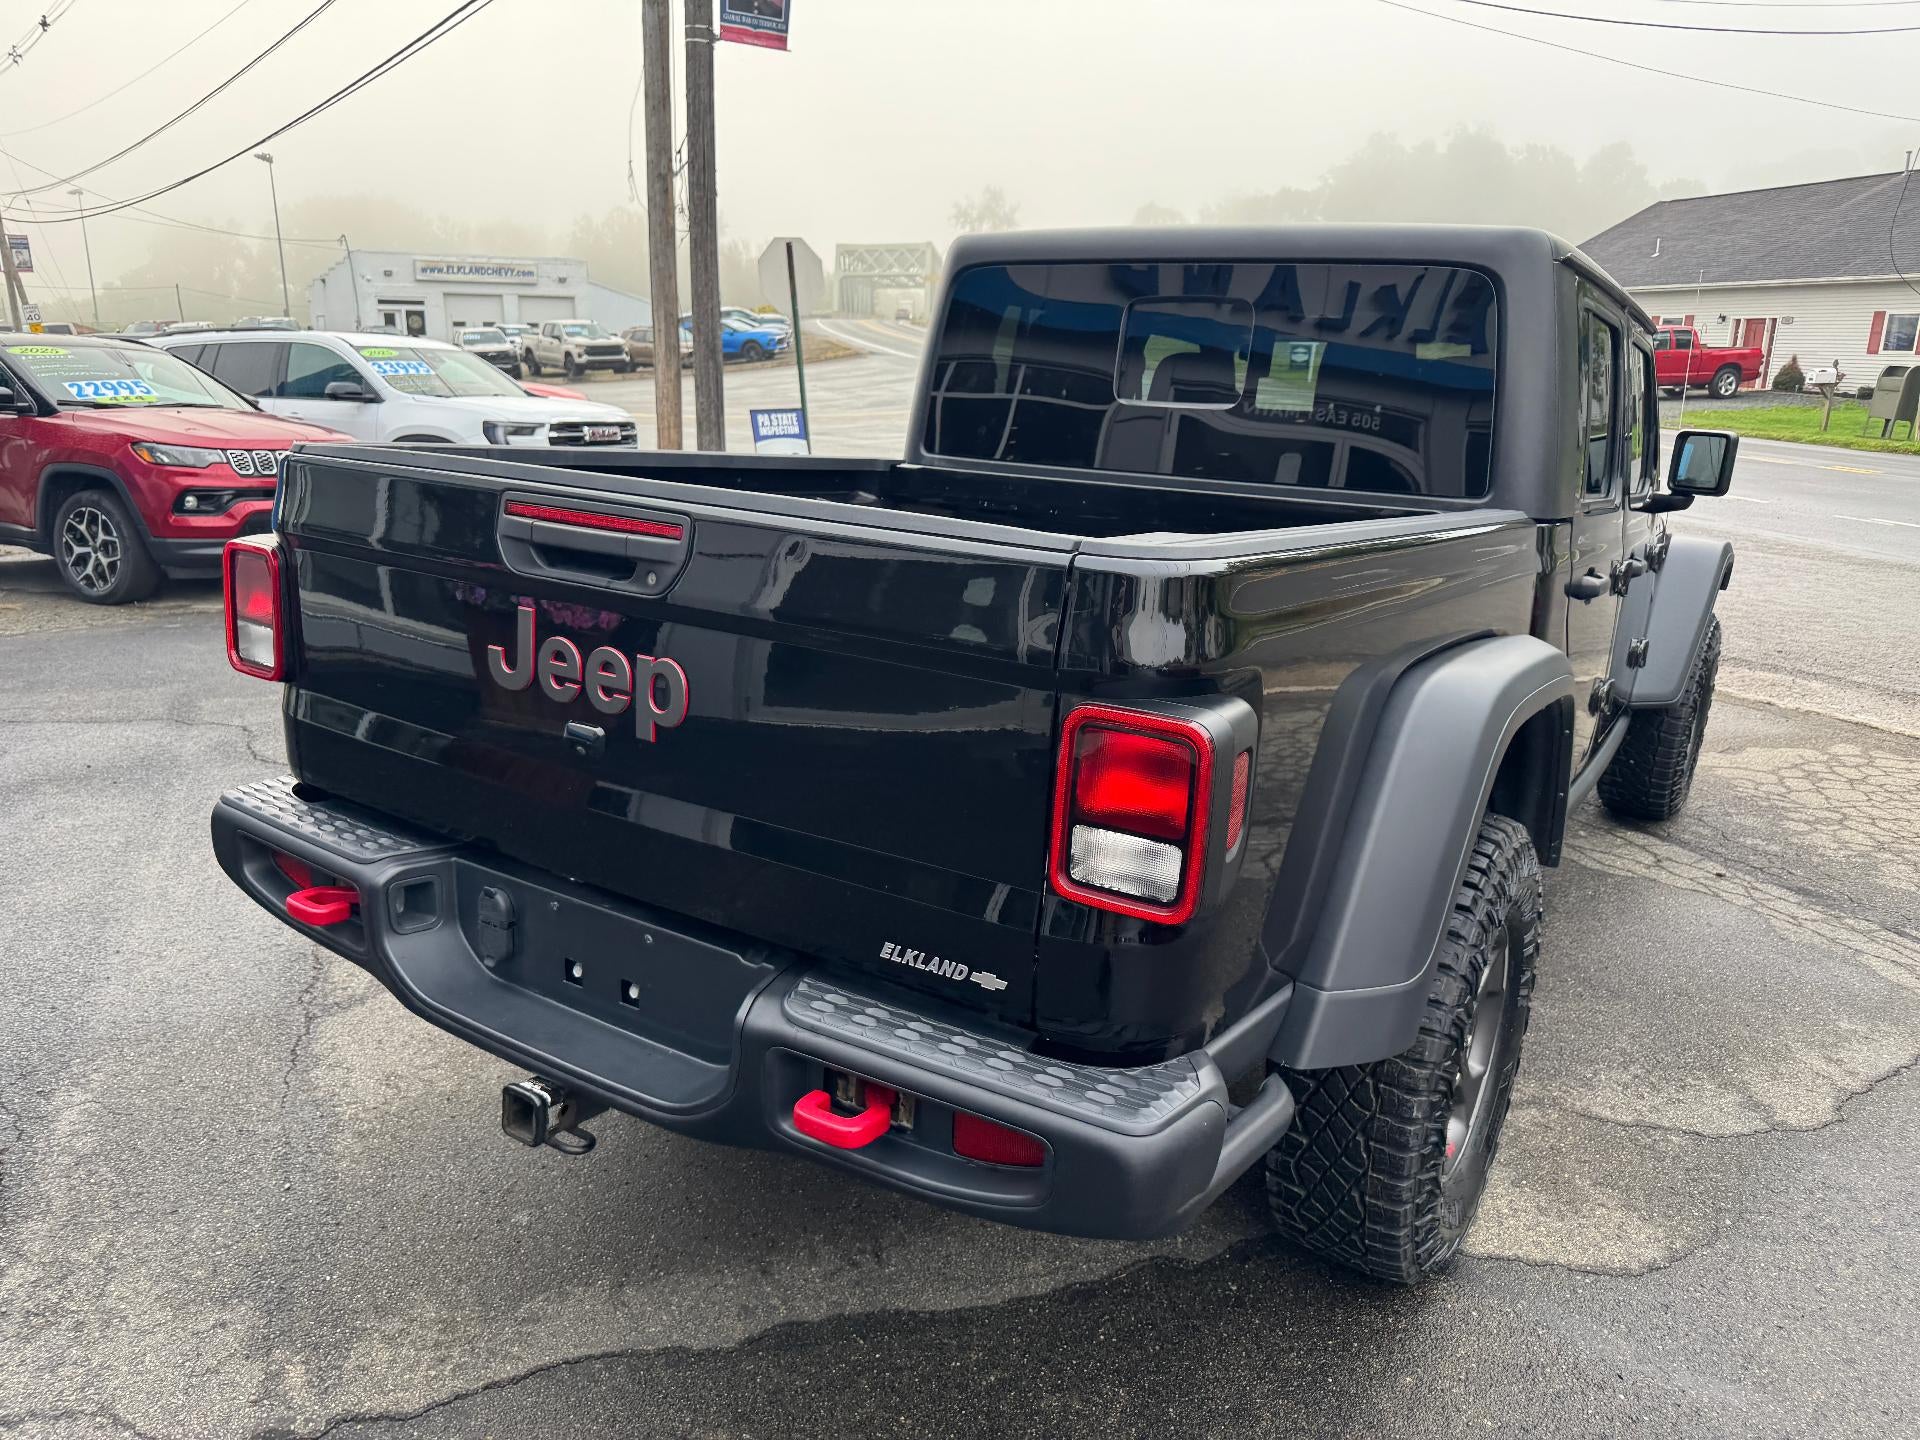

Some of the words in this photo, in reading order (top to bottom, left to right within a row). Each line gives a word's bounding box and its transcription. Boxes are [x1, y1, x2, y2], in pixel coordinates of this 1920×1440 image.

[421, 265, 535, 277] www.ELKLANDCHEVY.com
[27, 313, 41, 321] 40
[371, 360, 431, 375] 33995
[67, 380, 153, 398] 22995
[757, 413, 770, 426] PA
[770, 412, 798, 425] STATE
[759, 425, 799, 436] INSPECTION
[487, 605, 689, 742] Jeep
[879, 941, 969, 981] ELKLAND
